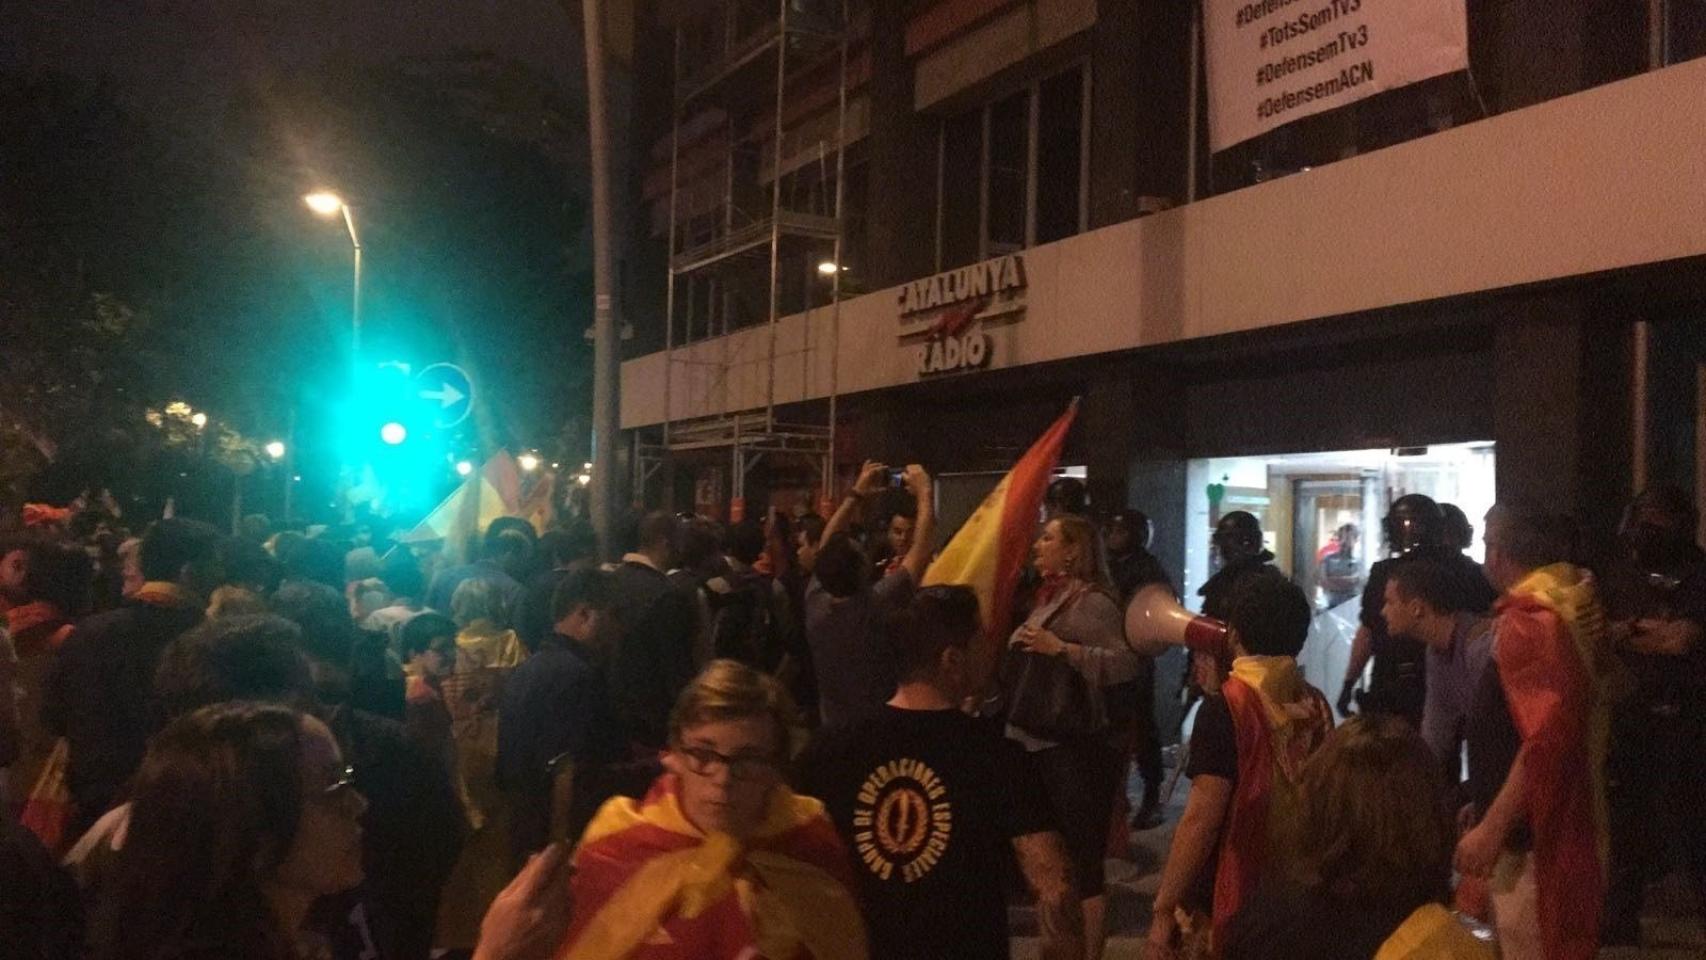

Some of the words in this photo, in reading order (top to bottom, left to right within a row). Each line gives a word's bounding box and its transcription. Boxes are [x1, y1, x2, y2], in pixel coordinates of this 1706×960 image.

[1256, 24, 1369, 86] #DefensemTv3
[1256, 59, 1374, 120] #DefensemACN
[897, 254, 1024, 315] CATALUNYA
[857, 758, 948, 805] OPERACIONES
[853, 808, 875, 827] DE
